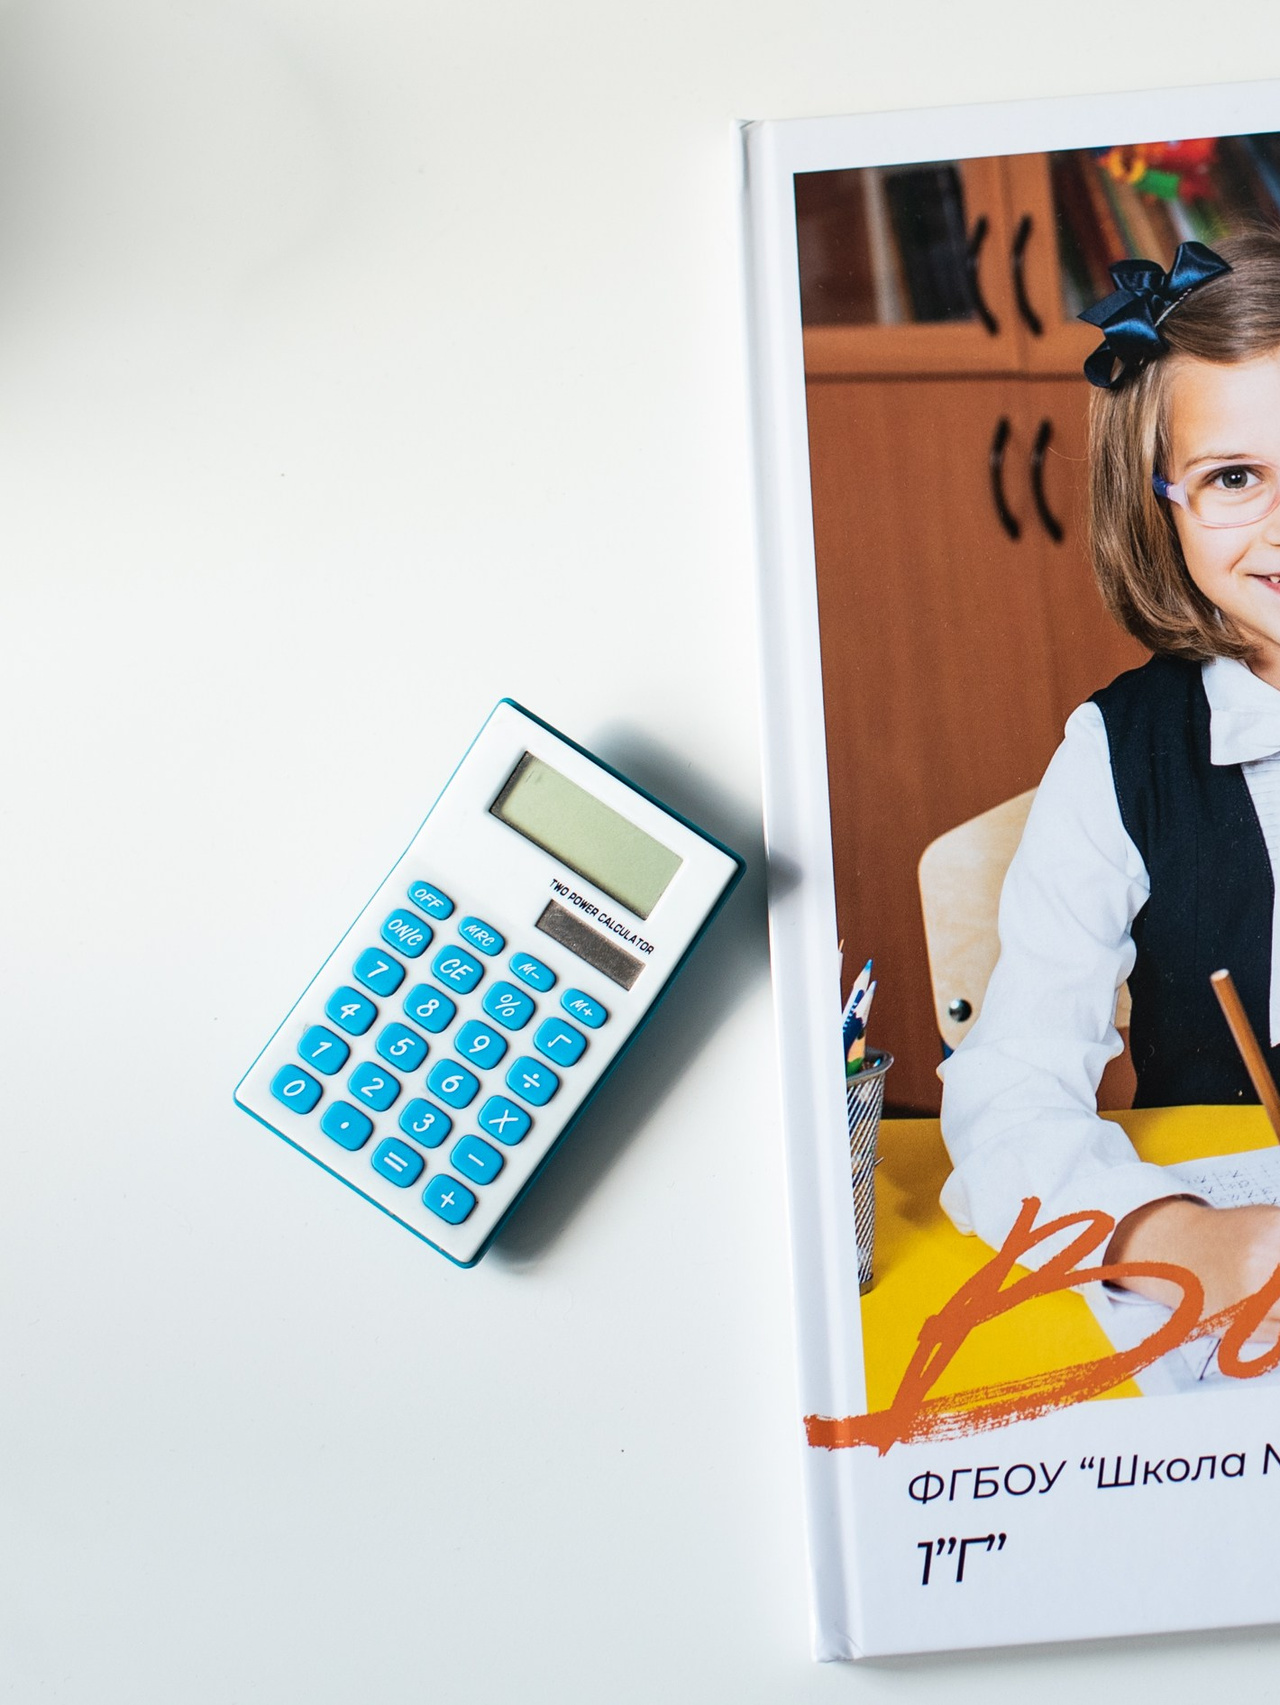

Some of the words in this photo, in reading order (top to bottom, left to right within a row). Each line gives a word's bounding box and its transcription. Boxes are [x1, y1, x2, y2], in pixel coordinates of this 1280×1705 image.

[387, 918, 424, 947] ON/C
[439, 958, 474, 981] CE
[414, 888, 444, 910] OFF
[464, 923, 495, 947] MRC
[549, 878, 569, 897] TWO
[568, 891, 600, 917] POWER
[598, 912, 655, 955] CALCULATOR
[367, 962, 389, 980] 7
[416, 998, 440, 1018] 8
[469, 1035, 491, 1053] 9
[311, 1041, 332, 1058] 1
[360, 1078, 385, 1098] 2
[412, 1113, 436, 1132] 3
[340, 1003, 361, 1020] 4
[389, 1037, 415, 1056] 5
[441, 1075, 464, 1093] 6
[908, 1459, 1067, 1505] ФГБОУ
